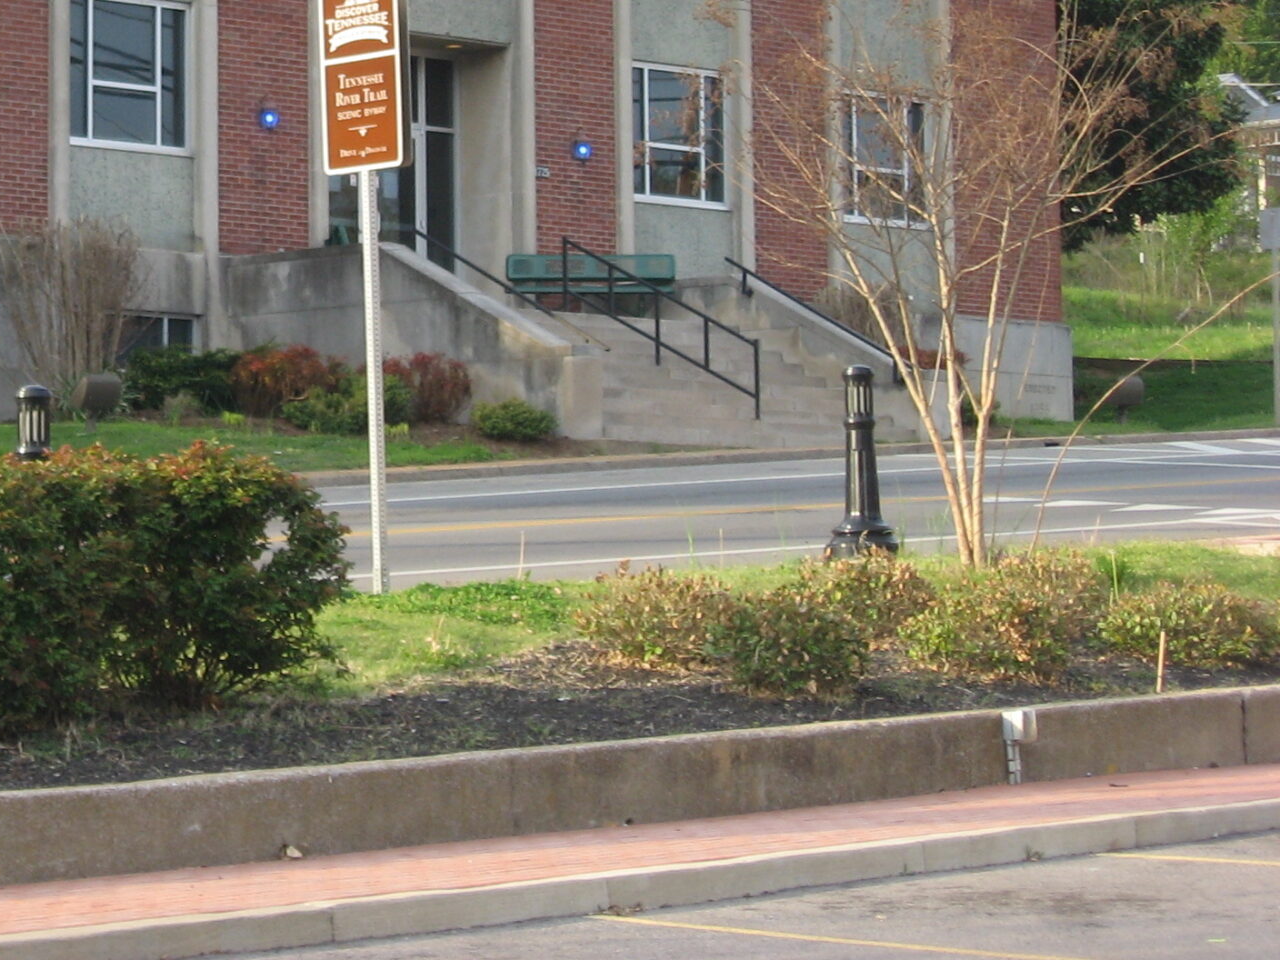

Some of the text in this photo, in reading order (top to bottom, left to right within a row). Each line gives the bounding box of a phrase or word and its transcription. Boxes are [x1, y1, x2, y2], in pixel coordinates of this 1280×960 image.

[334, 3, 379, 19] DISCOVER
[325, 11, 390, 36] TENNESSEE
[337, 73, 384, 89] TENNESSEE
[335, 88, 388, 107] RIVER TRAIL
[337, 106, 387, 121] SCENIC BYWAY
